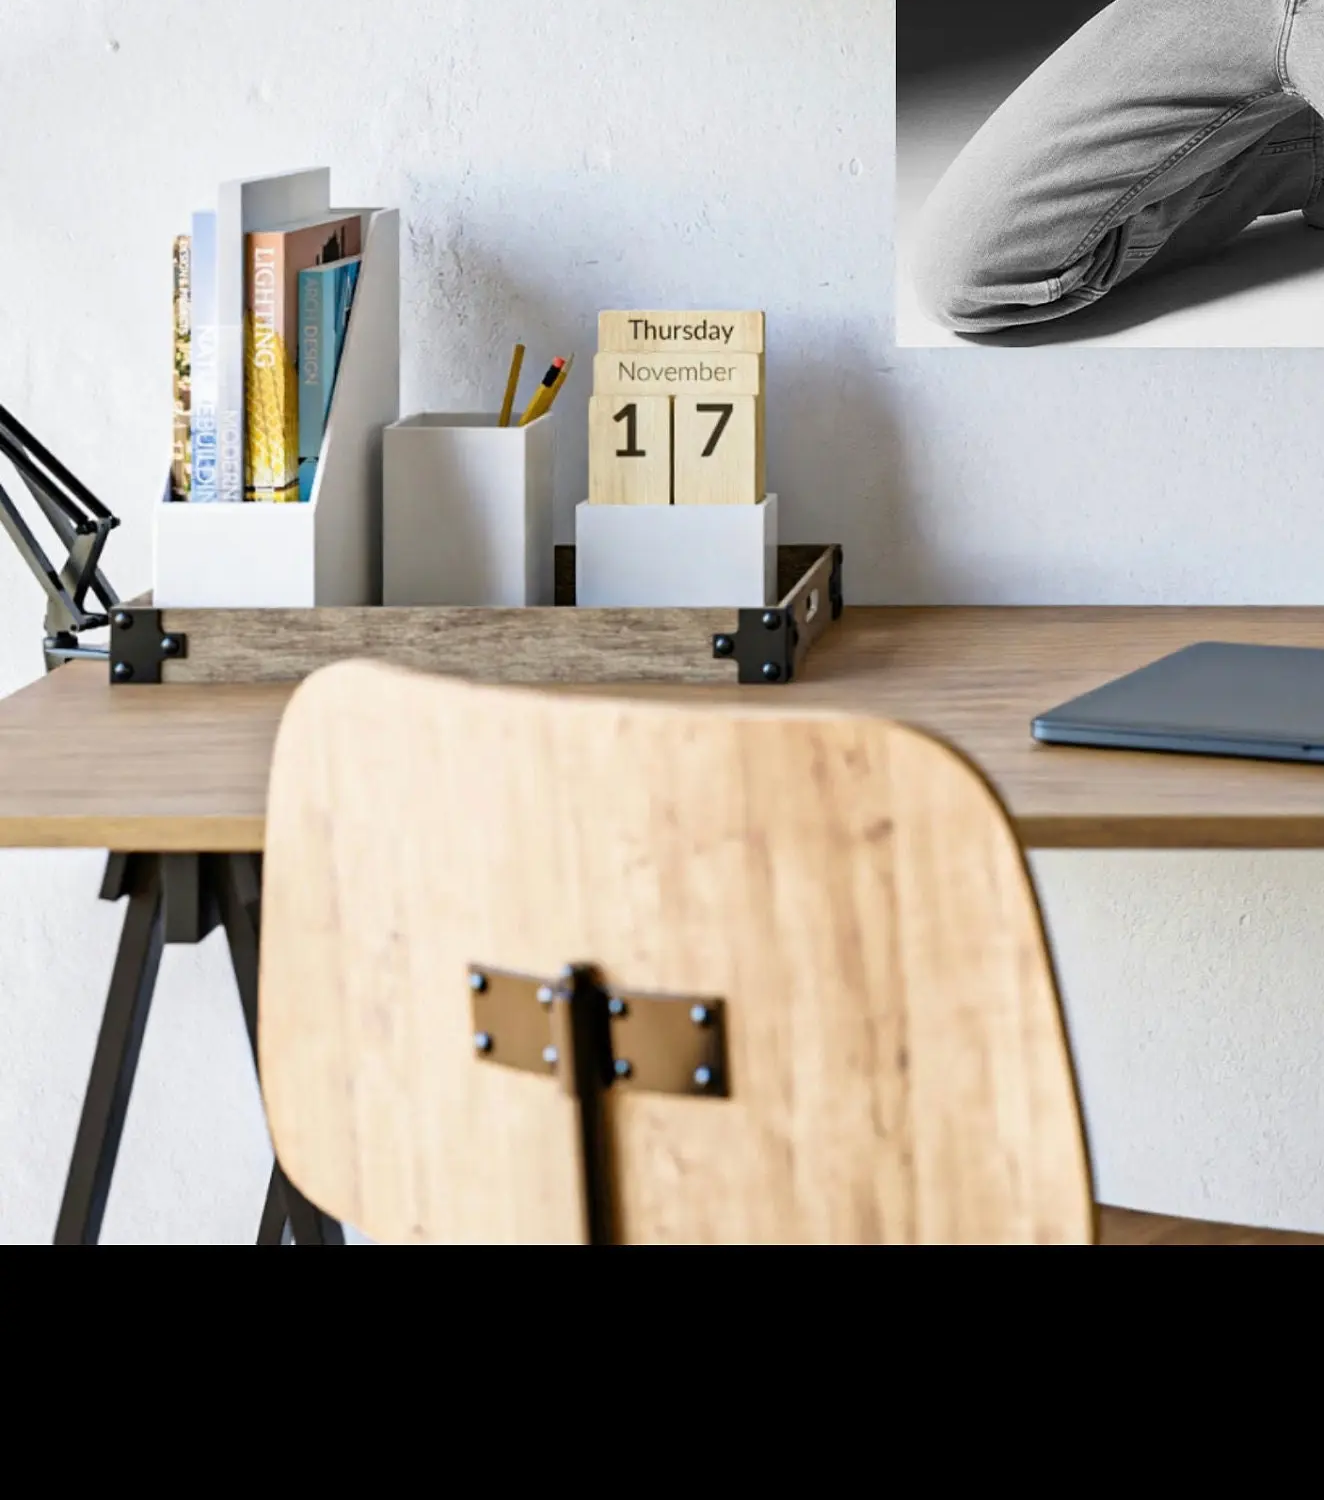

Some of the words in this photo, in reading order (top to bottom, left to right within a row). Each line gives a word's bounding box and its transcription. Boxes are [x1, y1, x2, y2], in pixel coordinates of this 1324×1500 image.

[254, 247, 276, 369] LIGHTING
[628, 319, 735, 344] Thursday
[303, 325, 319, 385] DESIGN
[618, 361, 737, 383] November
